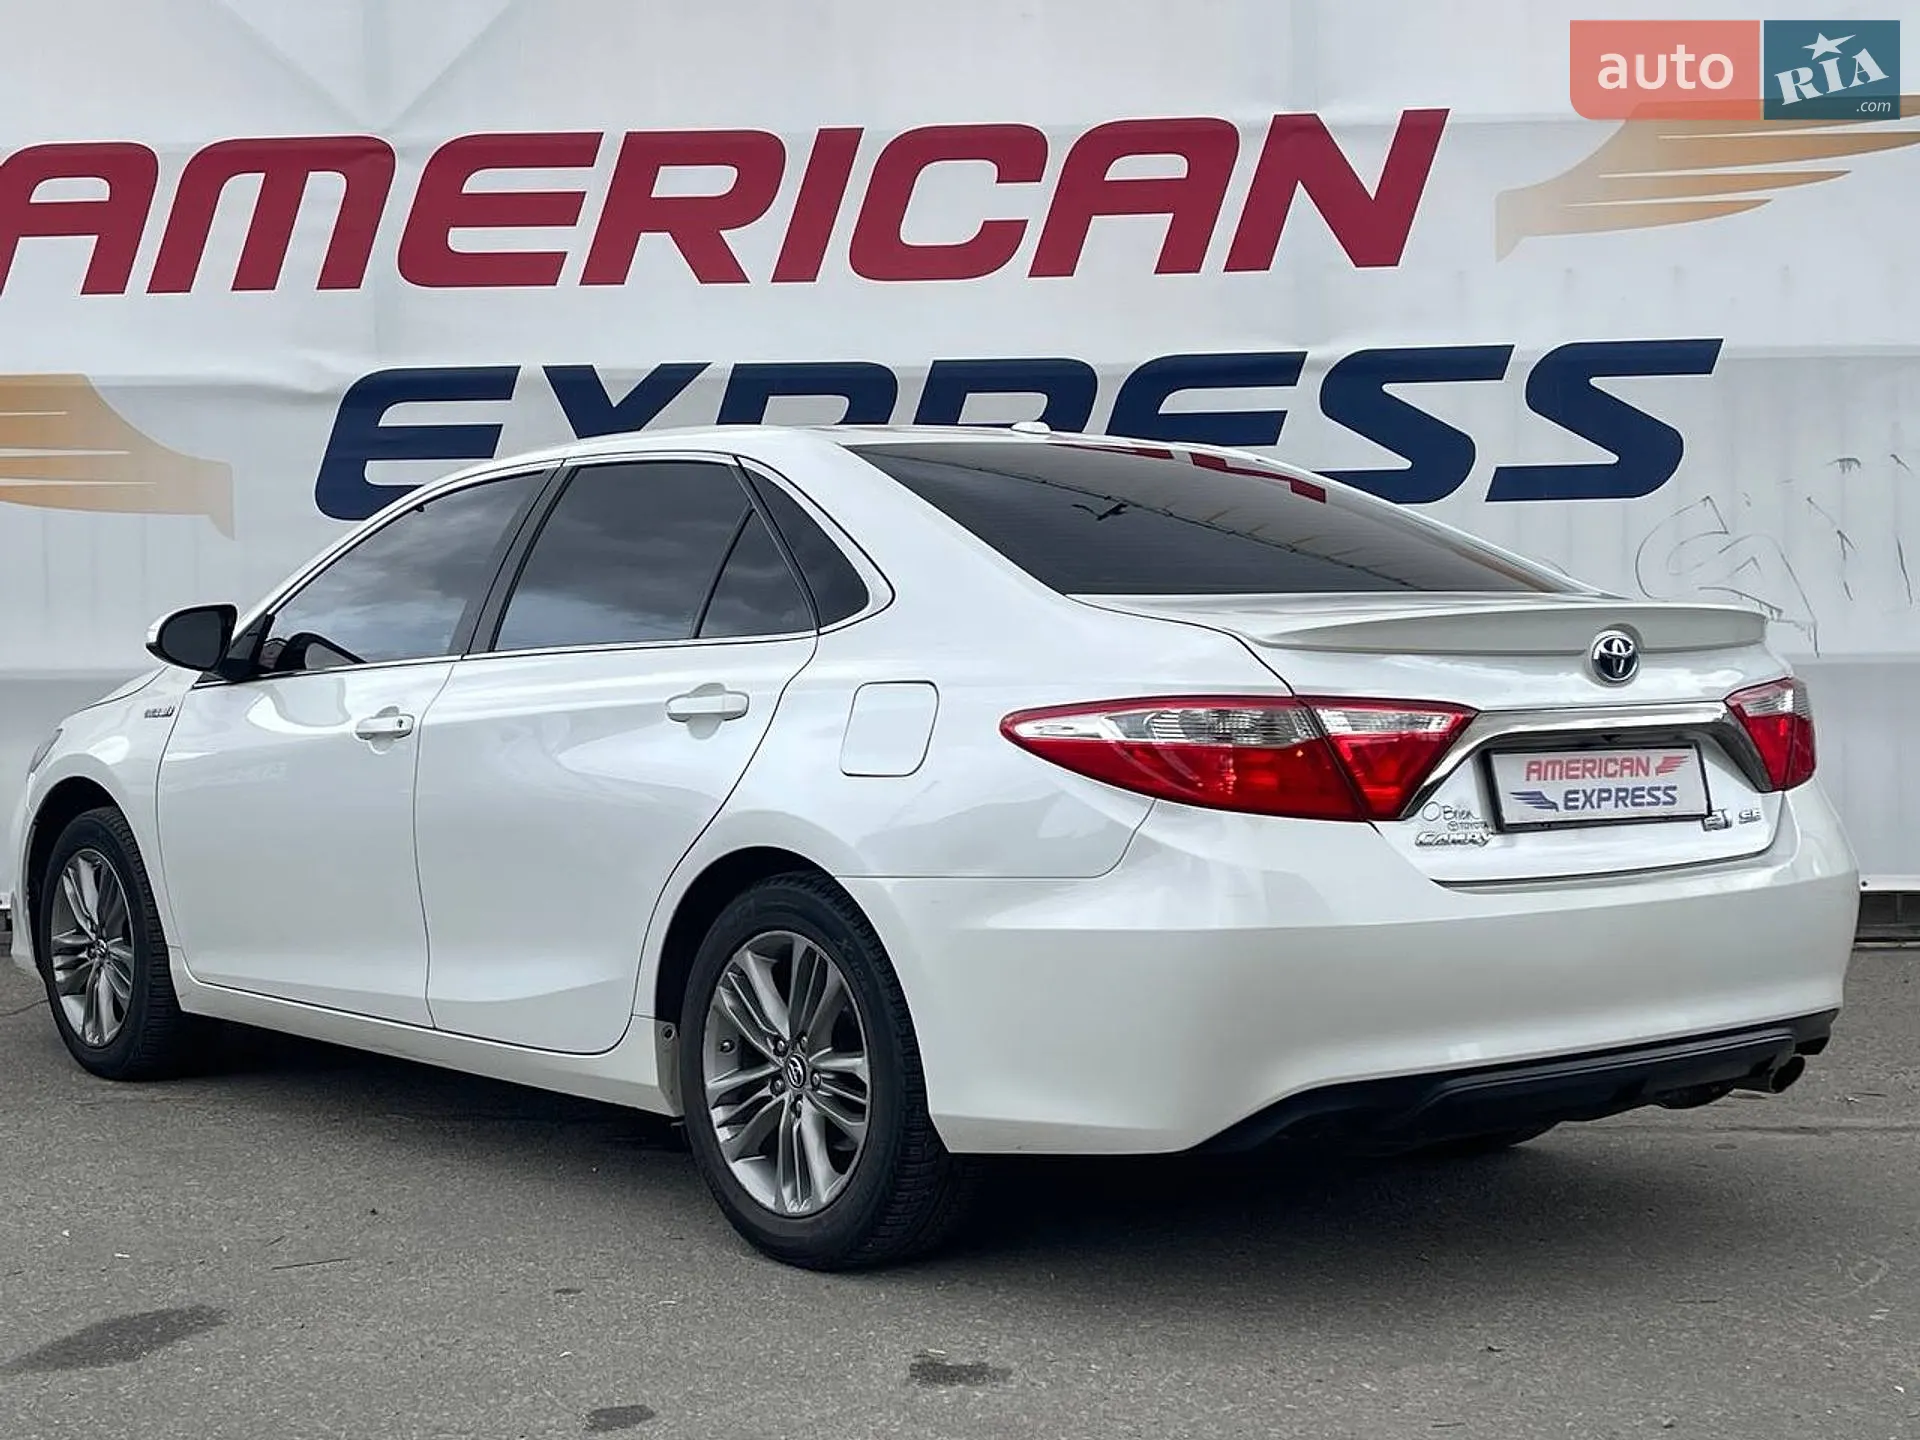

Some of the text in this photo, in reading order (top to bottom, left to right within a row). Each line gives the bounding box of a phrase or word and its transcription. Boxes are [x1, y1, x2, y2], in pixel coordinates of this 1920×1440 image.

[0, 108, 1449, 296] AMERICAN
[1526, 756, 1651, 782] AMERICAN
[1564, 785, 1678, 811] EXPRESS
